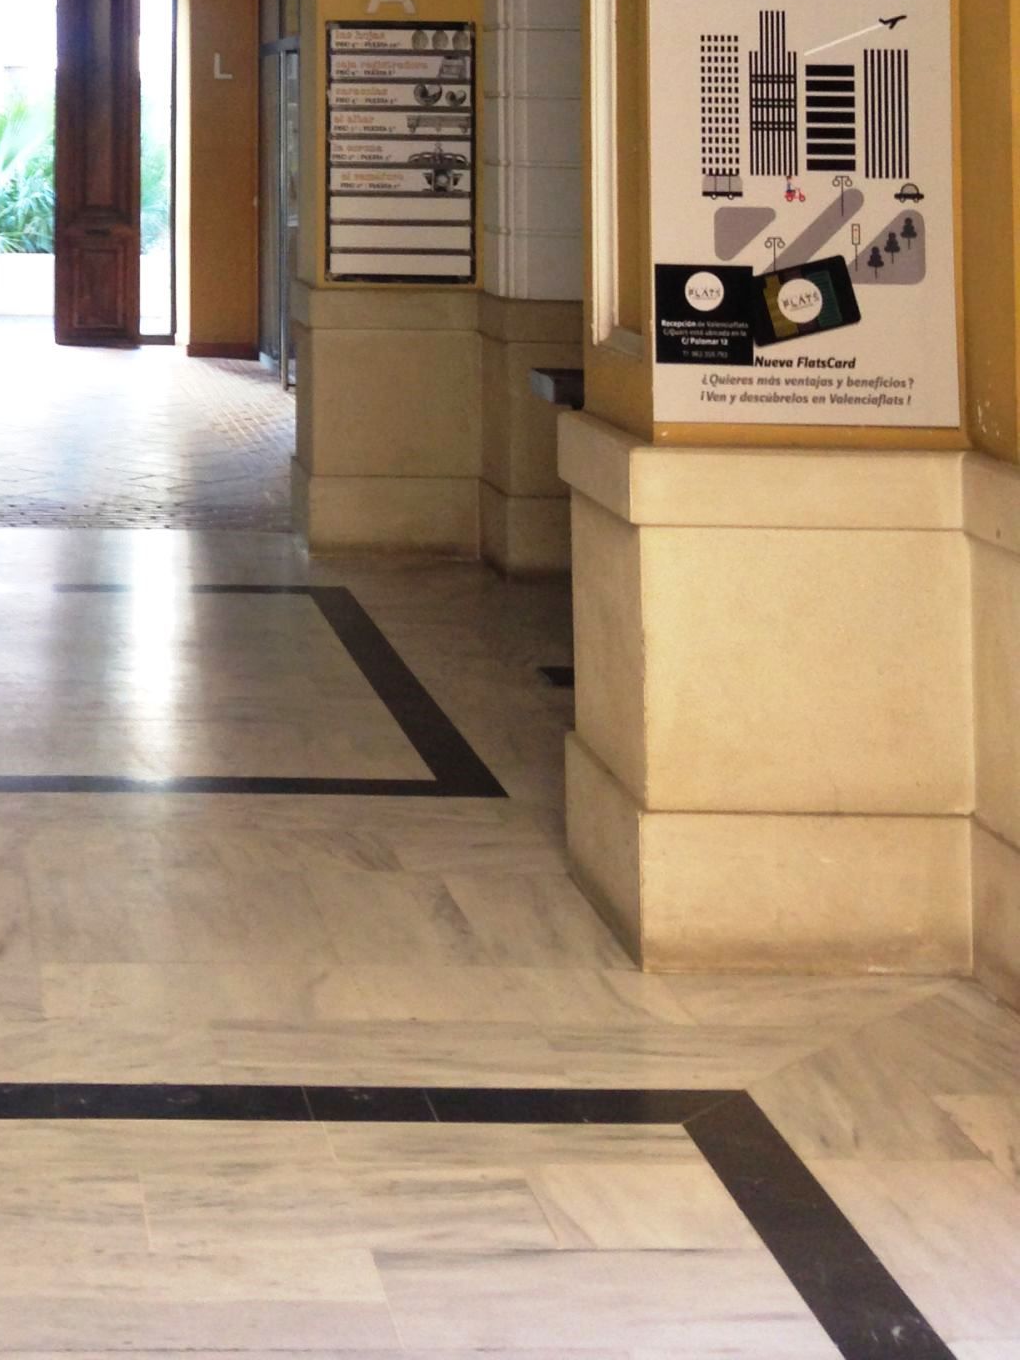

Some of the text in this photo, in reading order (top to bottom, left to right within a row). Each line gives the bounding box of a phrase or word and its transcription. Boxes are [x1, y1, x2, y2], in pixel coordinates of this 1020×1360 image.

[214, 52, 233, 80] L
[661, 319, 696, 328] Recepción
[690, 337, 719, 345] Palomar
[754, 356, 856, 369] Nueva FlatsCard
[757, 374, 781, 386] más
[784, 374, 833, 389] ventajas
[836, 377, 843, 389] y
[729, 393, 736, 404] y
[739, 391, 809, 404] descúbrelos
[812, 394, 826, 404] en
